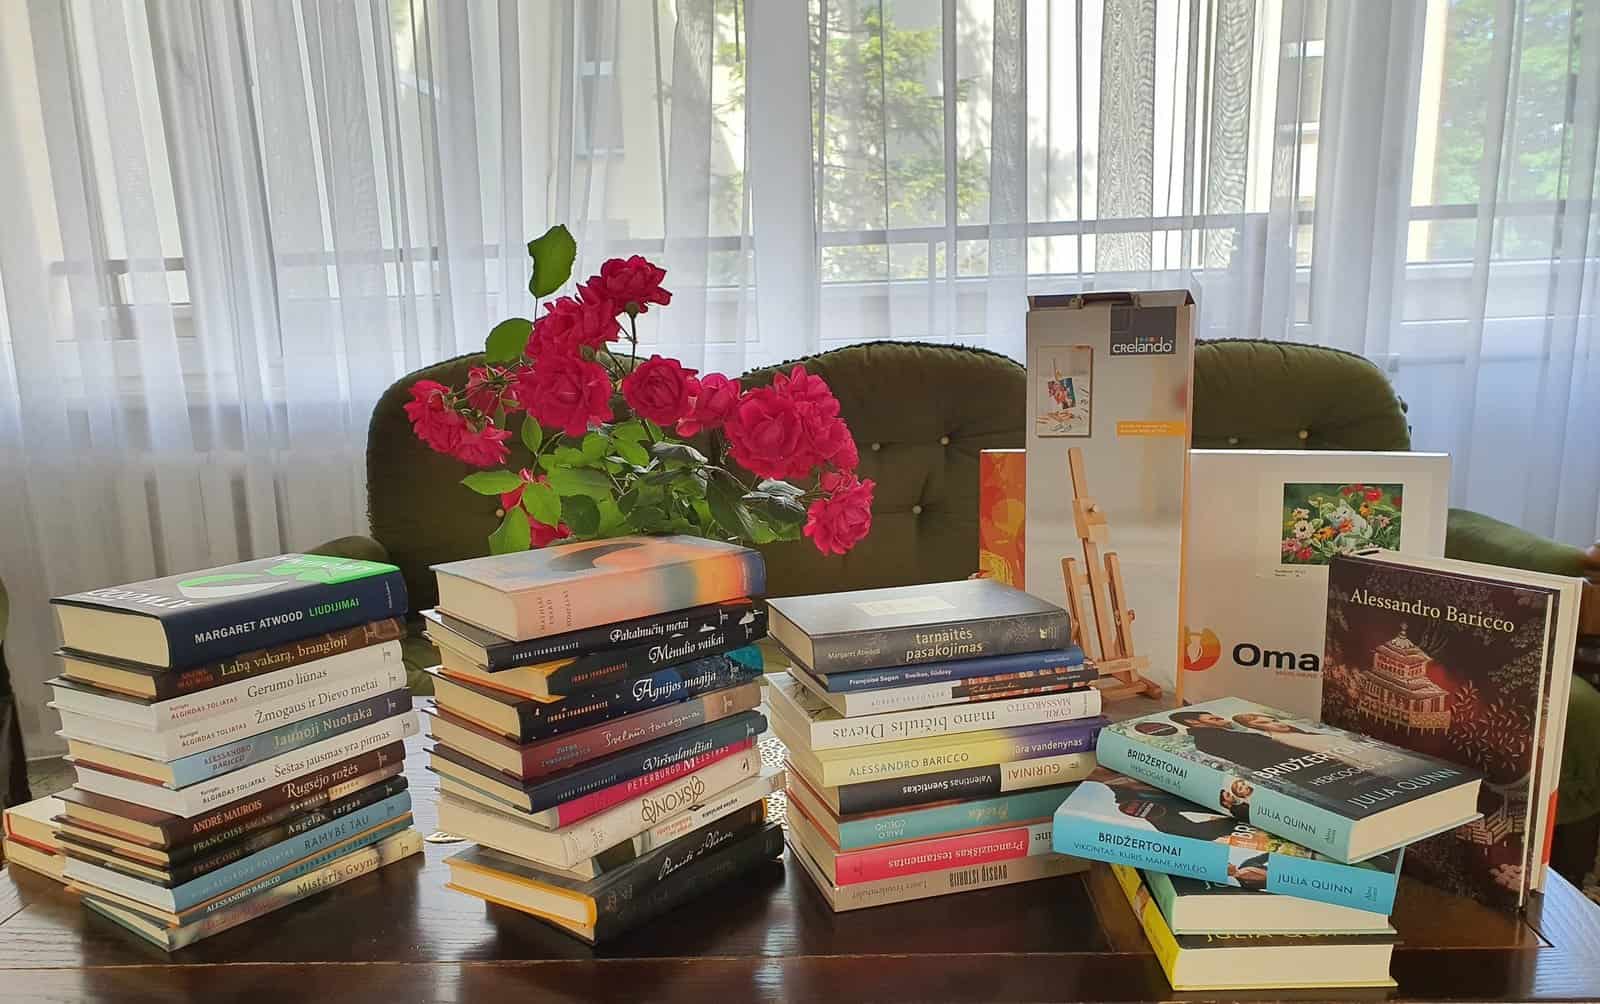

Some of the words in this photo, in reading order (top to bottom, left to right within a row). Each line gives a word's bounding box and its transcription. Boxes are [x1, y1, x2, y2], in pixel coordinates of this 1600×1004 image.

[194, 622, 257, 645] MARGARET
[259, 610, 304, 630] ATWOOD
[309, 598, 360, 617] LIUDIJIMAI
[1349, 588, 1442, 620] Alessandro
[1446, 606, 1515, 634] Baricco
[609, 623, 665, 644] Pakalnučių
[666, 617, 689, 633] metai
[915, 628, 973, 645] tarnaitės
[220, 662, 251, 678] Labą
[254, 650, 295, 669] vakarą,
[297, 635, 348, 658] brangioji
[648, 640, 696, 664] Mėnulio
[698, 633, 725, 652] vaikai
[905, 642, 983, 663] pasakojimas
[247, 679, 294, 699] Gerumo
[296, 668, 328, 686] liūnas
[632, 677, 682, 702] Agnijos
[684, 671, 717, 692] magija
[255, 702, 307, 725] Žmogaus
[309, 698, 316, 709] ir
[318, 689, 349, 706] Dievo
[351, 681, 379, 696] metai
[322, 708, 373, 731] Nuotaka
[891, 716, 948, 736] bičiulis
[954, 709, 996, 724] mano
[832, 719, 885, 741] Dievas
[274, 760, 305, 778] Šeštas
[306, 747, 343, 769] jausmas
[344, 742, 359, 756] yra
[360, 731, 391, 750] pirmas
[1031, 736, 1083, 756] vandenynas
[849, 756, 919, 777] ALESSANDRO
[922, 751, 969, 768] BARICCO
[1007, 762, 1061, 780] GURINIAI
[1127, 749, 1188, 780] BRIDŽERTONAI
[282, 774, 329, 800] Rugsėjo
[333, 763, 358, 783] rožės
[627, 763, 682, 793] PETERBURGO
[901, 781, 949, 795] Sventickas
[950, 775, 993, 788] Valentinas
[1348, 786, 1403, 810] JULIA
[1397, 768, 1464, 791] QUINN
[223, 800, 263, 824] MAUROIS
[1257, 805, 1281, 823] JULIA
[1283, 815, 1317, 835] QUINN
[1098, 832, 1182, 857] BRIDŽERTONAI
[888, 850, 953, 870] testamentas
[296, 869, 344, 897] Misteris
[1277, 873, 1308, 887] JULIA
[1311, 880, 1353, 896] QUINN
